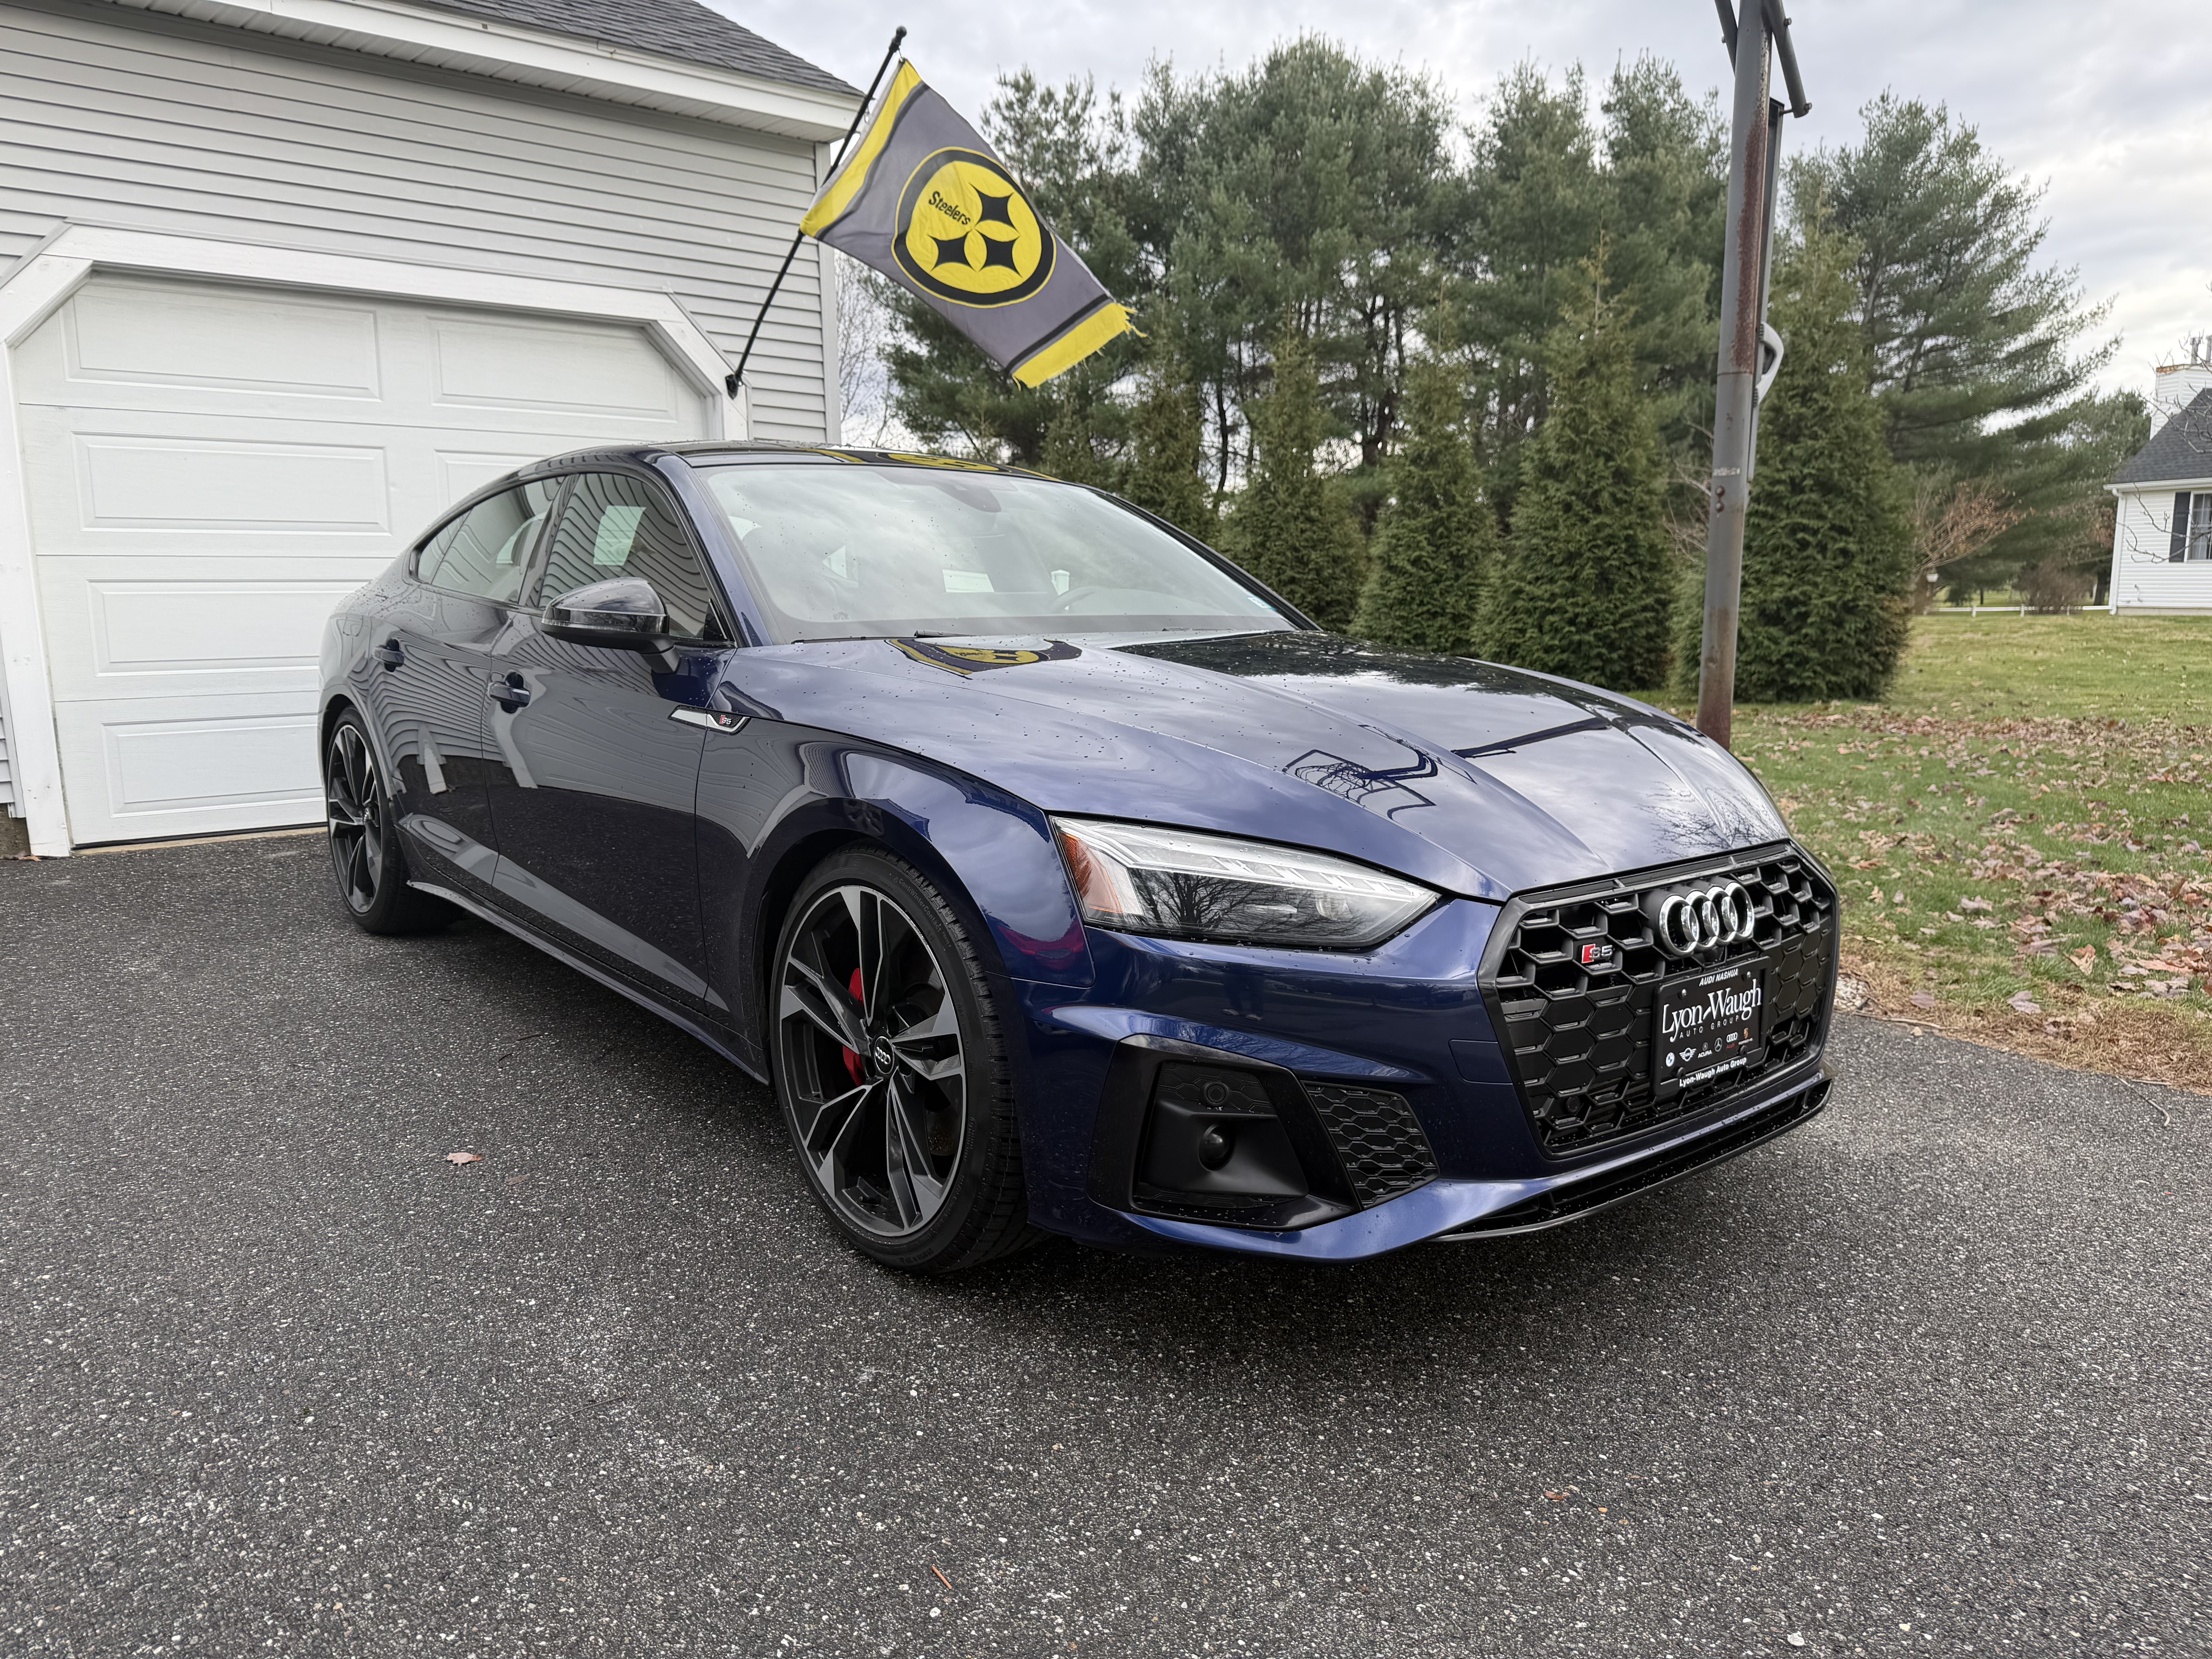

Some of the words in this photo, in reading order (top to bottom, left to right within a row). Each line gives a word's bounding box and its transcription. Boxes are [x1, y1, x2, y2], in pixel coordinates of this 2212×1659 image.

[929, 191, 970, 225] Steelers
[899, 878, 941, 932] ContiWinterContact
[1589, 945, 1613, 959] S5
[1699, 975, 1715, 986] AUDI
[1716, 968, 1738, 982] NASHUA
[1680, 1026, 1703, 1039] AUTO
[1711, 1015, 1739, 1030] GROUP
[1698, 1050, 1712, 1058] ACURA
[1716, 1062, 1729, 1074] Auto
[1730, 1057, 1747, 1070] Group
